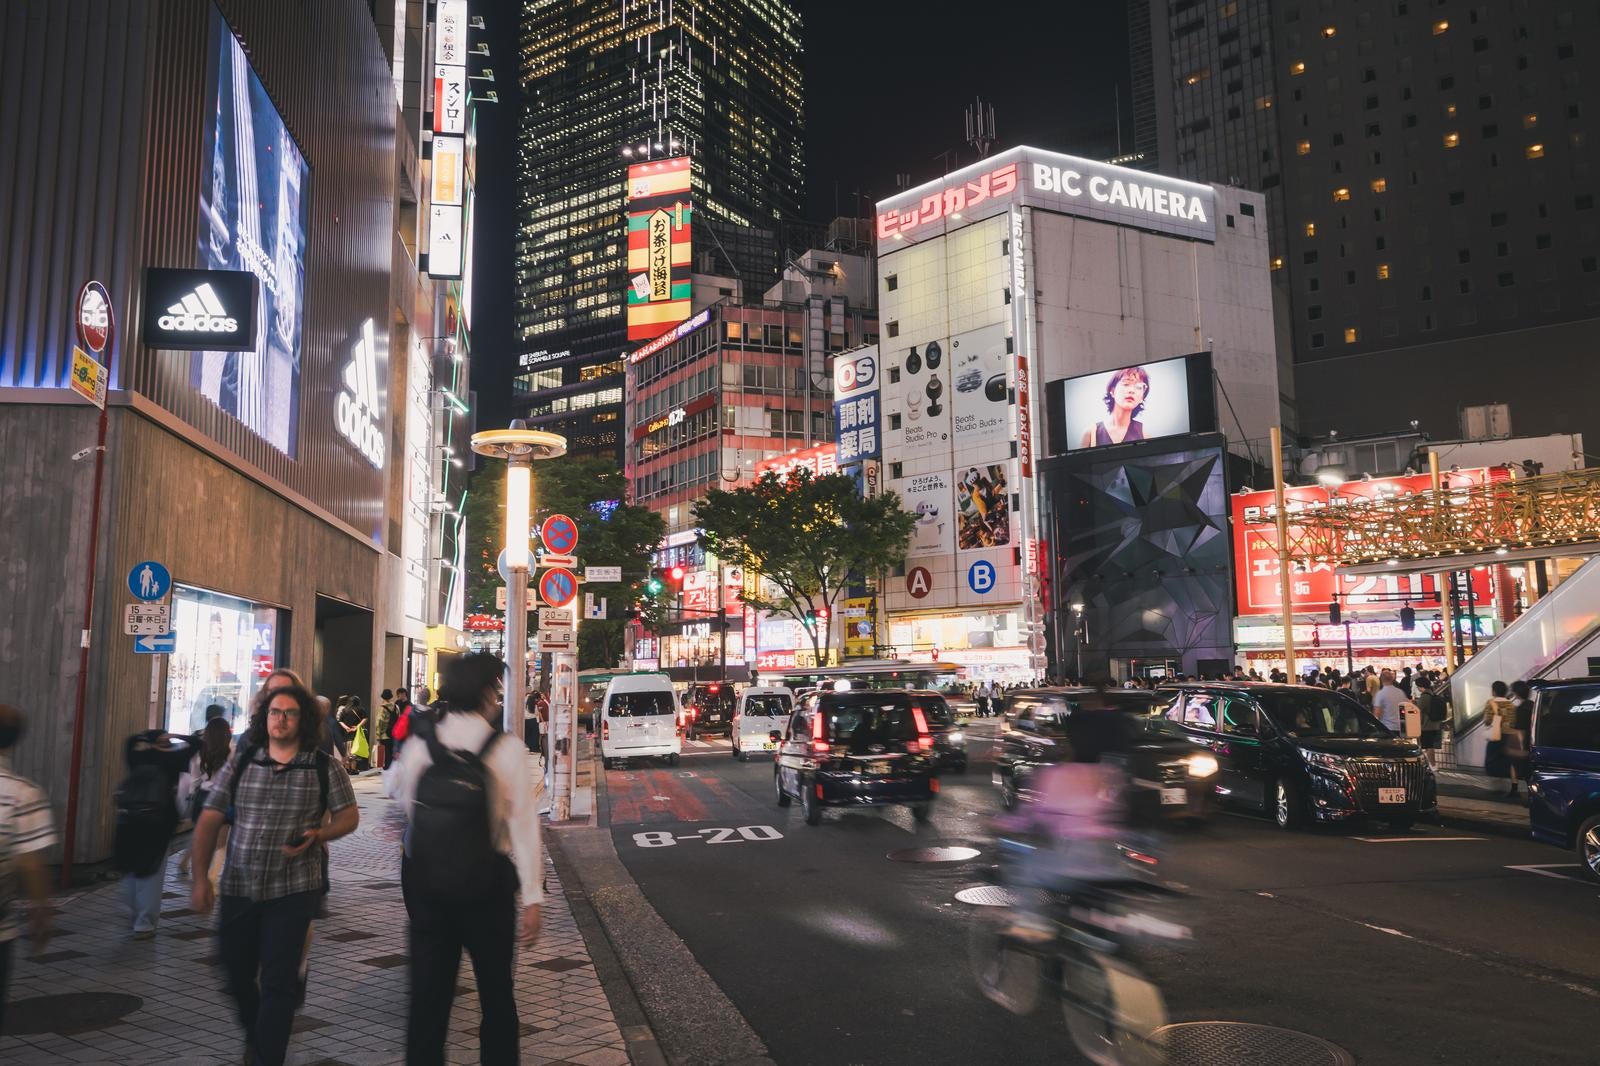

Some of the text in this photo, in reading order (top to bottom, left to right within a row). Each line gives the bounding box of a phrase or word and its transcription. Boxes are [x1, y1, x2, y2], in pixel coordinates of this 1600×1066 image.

[447, 82, 460, 130] スシロー
[437, 140, 443, 148] 5
[877, 162, 1018, 240] ビックカメラ
[1033, 162, 1208, 223] BIC CAMERA
[1012, 212, 1025, 297] BIC CAMERA
[157, 312, 239, 333] adidas
[528, 350, 548, 359] SHIBUYA
[528, 350, 571, 365] SCRAMBLE SQUARE
[837, 356, 876, 393] OS
[839, 396, 876, 432] 調剤
[955, 414, 975, 425] Beats
[335, 391, 385, 470] adidas
[905, 425, 923, 435] Beats
[955, 422, 978, 433] Studio
[979, 418, 998, 428] Buds
[840, 427, 876, 459] 薬局
[905, 431, 938, 444] Studio Pro
[911, 570, 929, 594] A
[974, 565, 991, 590] B
[131, 606, 140, 614] 15
[159, 606, 165, 615] 5
[545, 610, 570, 619] 20-7
[130, 625, 139, 633] 12
[158, 625, 165, 633] 5
[562, 633, 570, 641] 日
[632, 825, 785, 848] 8-20
